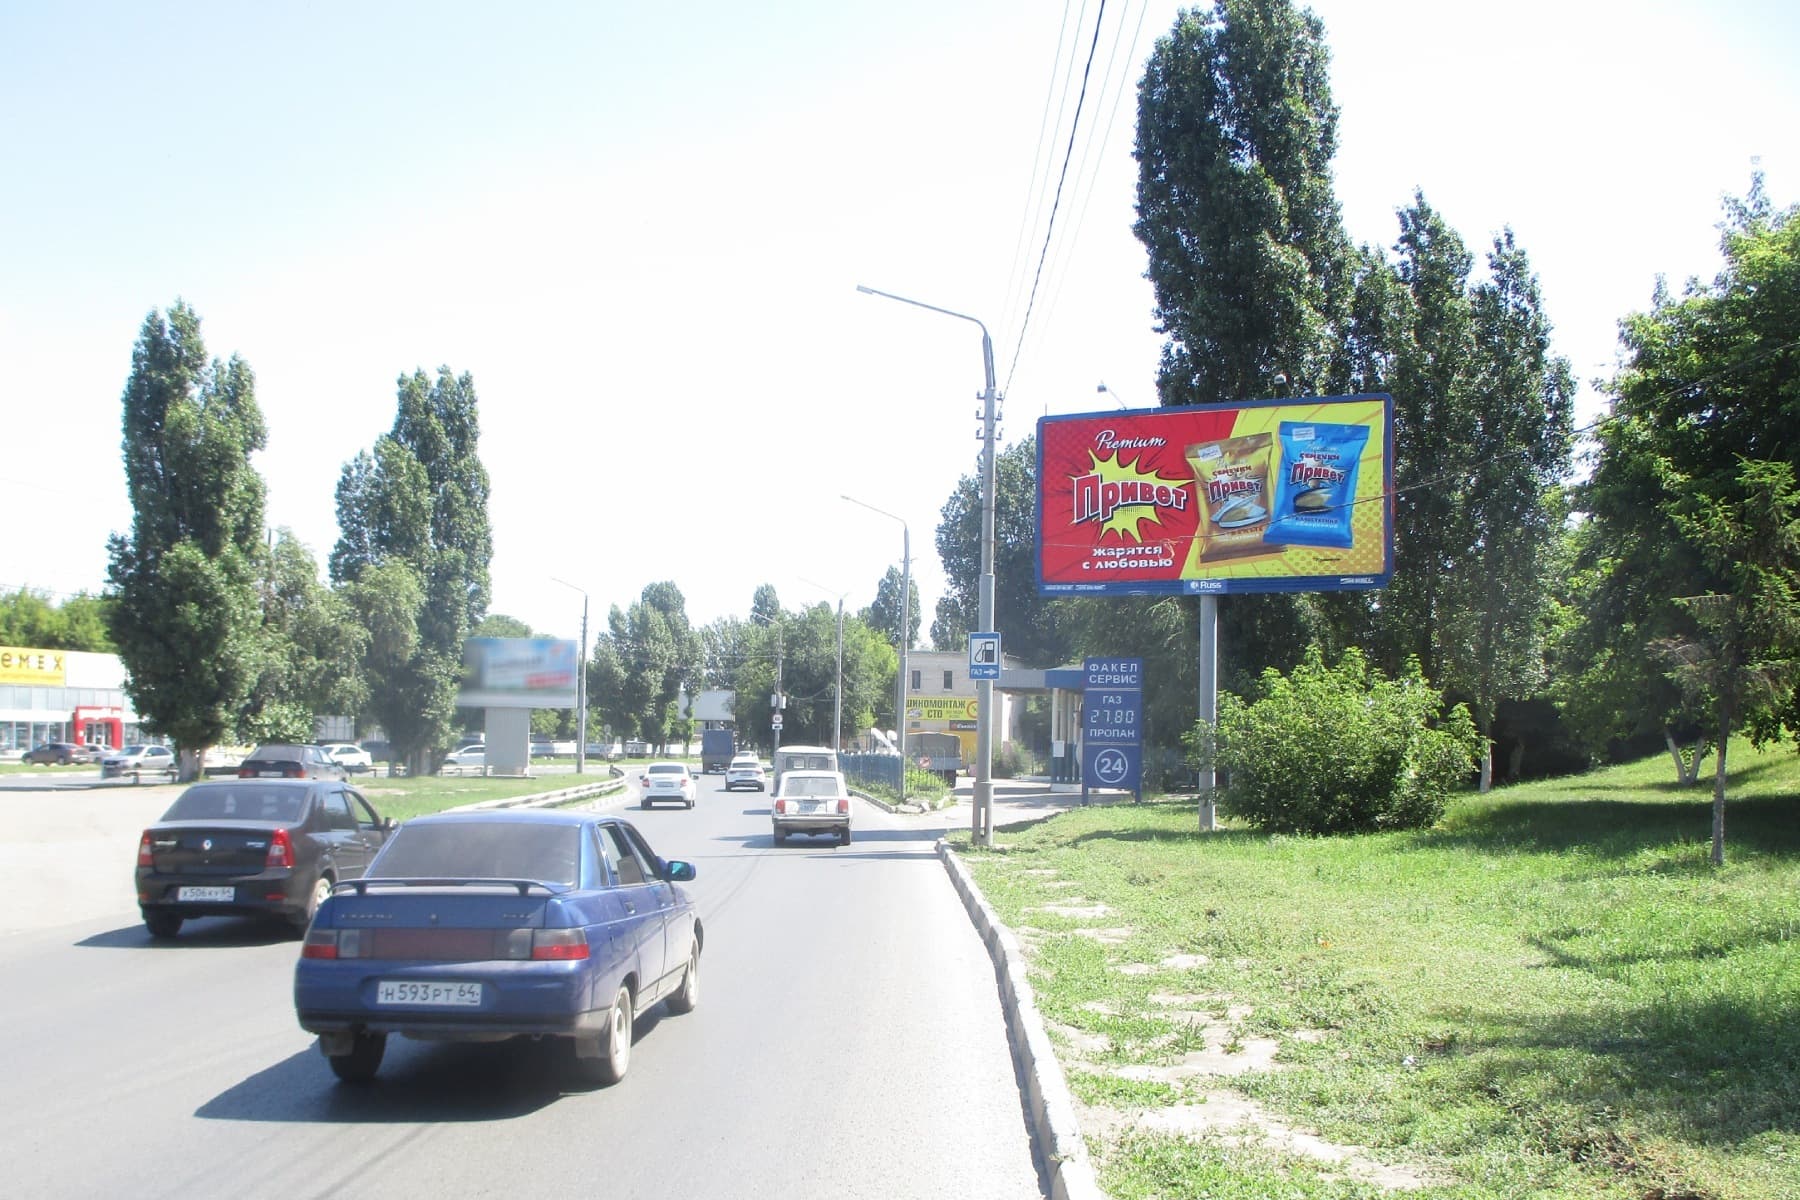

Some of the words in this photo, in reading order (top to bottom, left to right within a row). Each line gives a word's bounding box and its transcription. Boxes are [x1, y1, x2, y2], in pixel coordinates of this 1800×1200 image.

[1095, 430, 1166, 451] Premium
[1290, 463, 1345, 484] Привет
[1208, 480, 1262, 503] Привет
[1073, 474, 1188, 524] Привет
[1092, 545, 1163, 559] жарятся
[1082, 561, 1090, 570] с
[1094, 557, 1173, 569] любовью
[1200, 581, 1222, 589] Russ
[971, 668, 983, 676] ГАЗ
[1089, 663, 1138, 673] ФАКЕЛ
[1089, 674, 1137, 684] СЕРВИС
[1102, 695, 1122, 705] ГАЗ
[927, 709, 943, 719] СТО
[1090, 728, 1135, 738] ПРОПАН
[1100, 757, 1124, 774] 24
